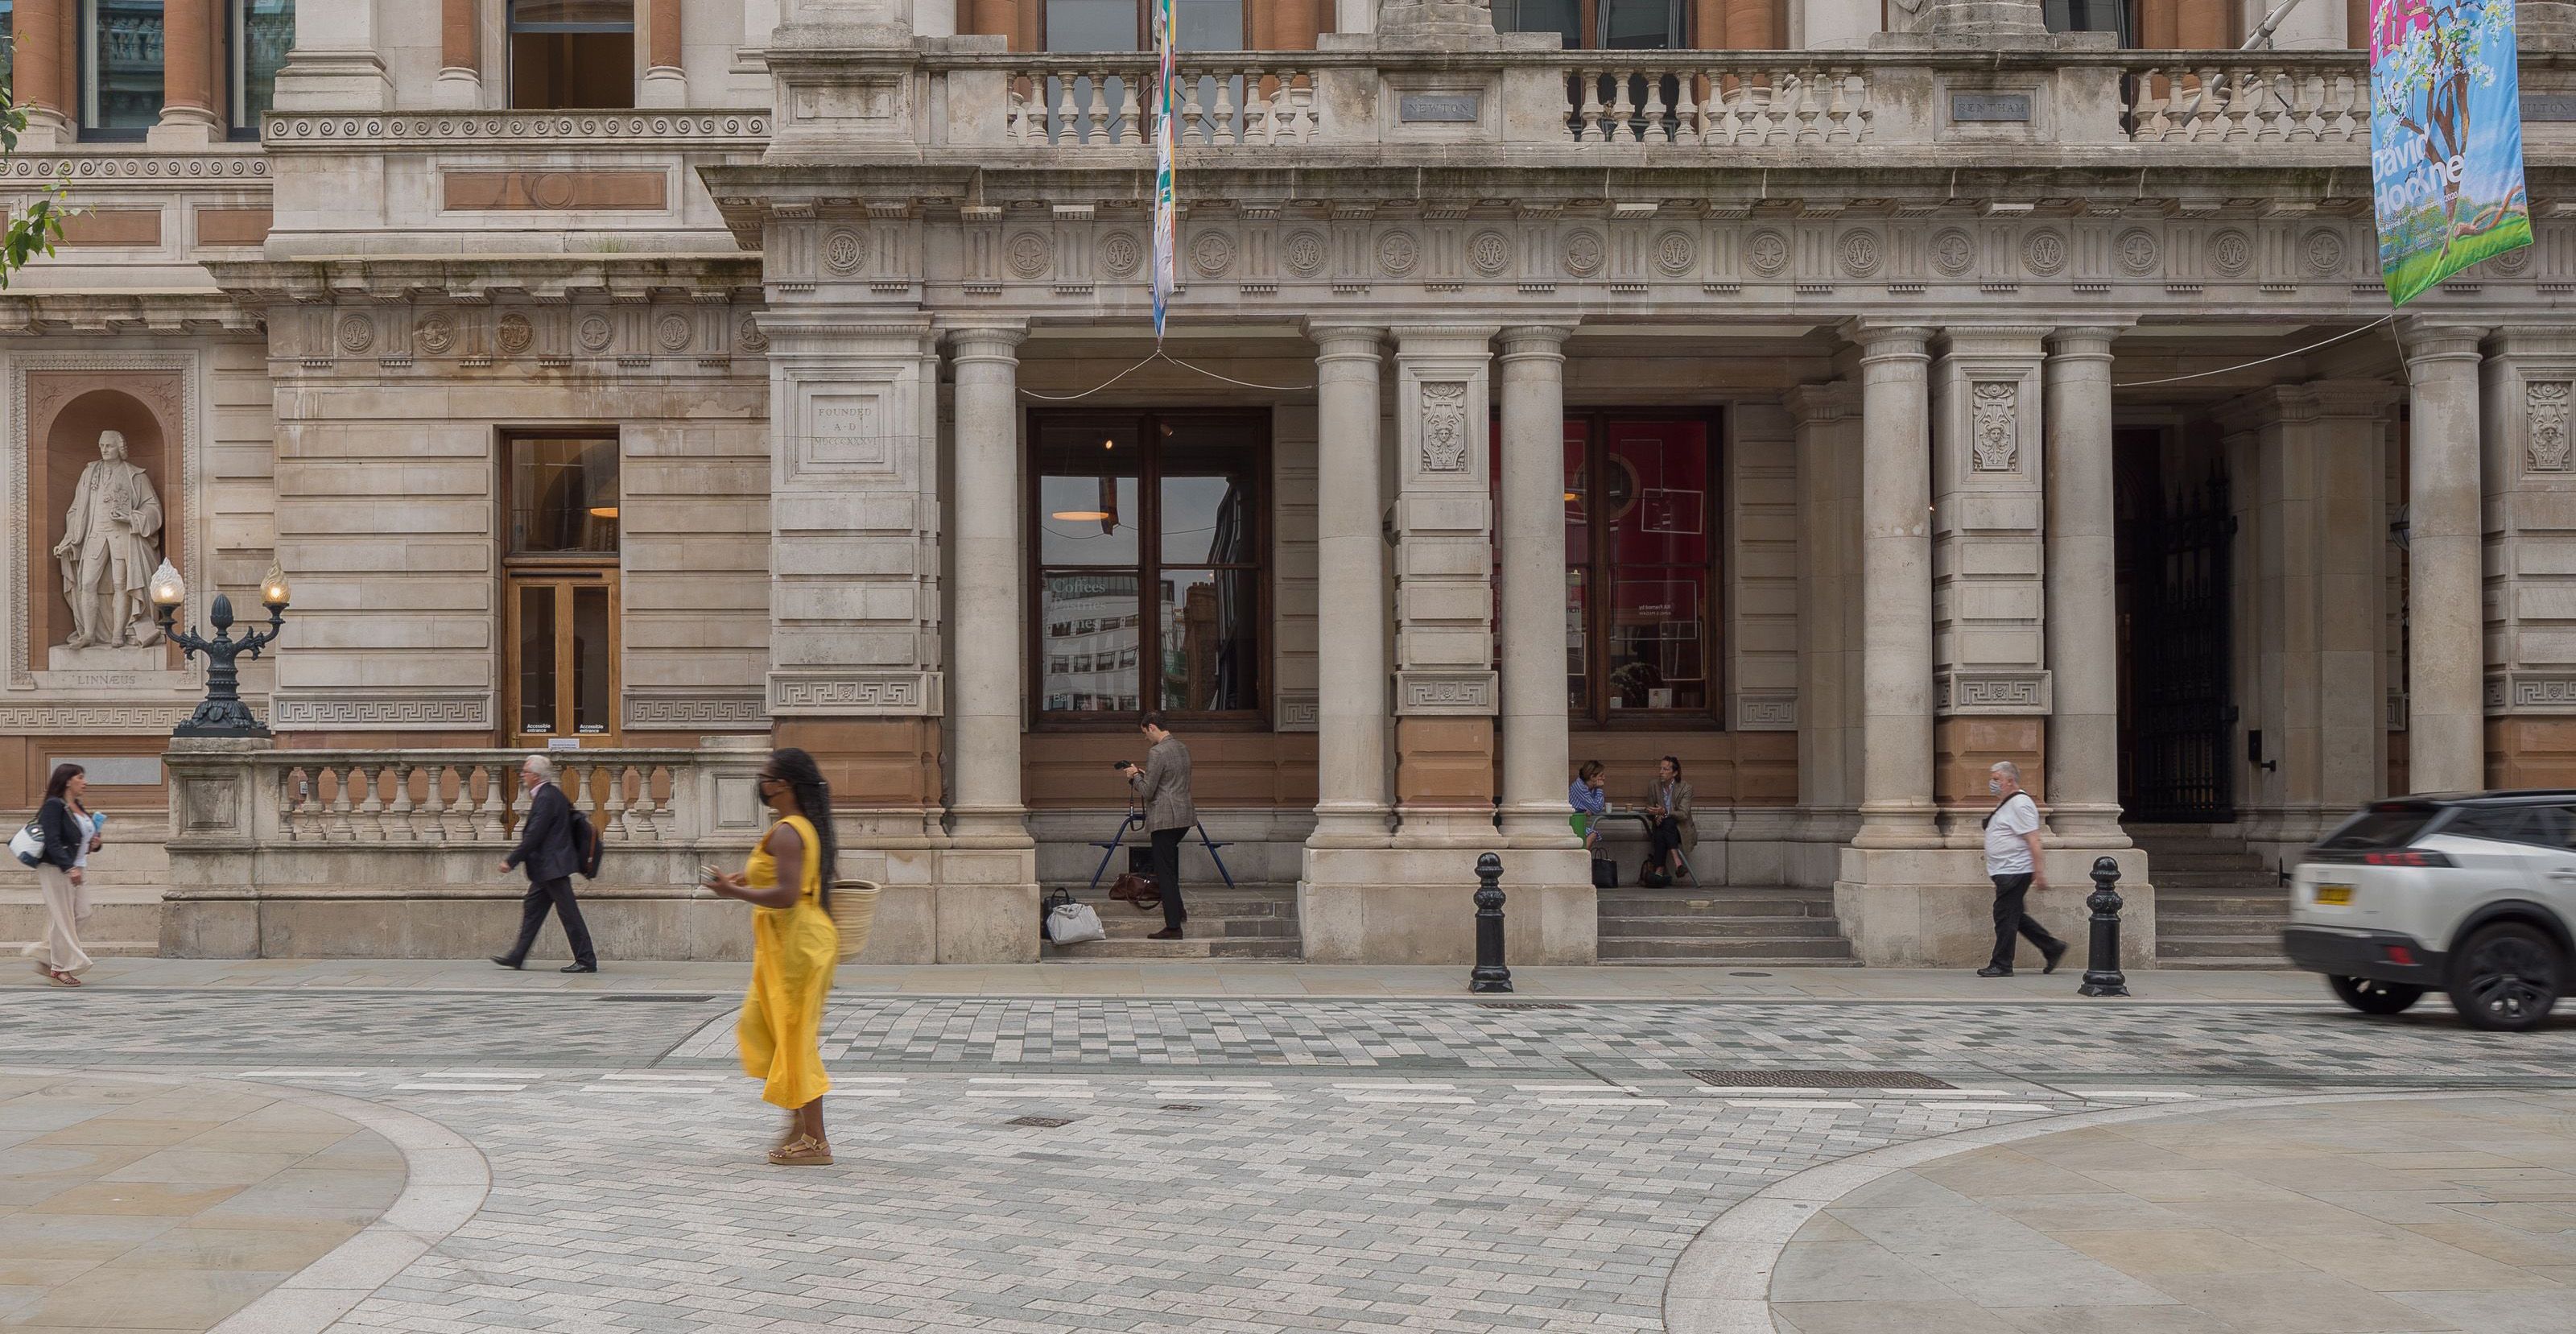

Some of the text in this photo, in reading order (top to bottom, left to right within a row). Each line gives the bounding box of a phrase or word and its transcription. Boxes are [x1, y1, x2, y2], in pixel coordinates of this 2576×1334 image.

[1408, 104, 1469, 114] NEWTON
[1958, 103, 2025, 113] BENTHAM
[2372, 122, 2429, 184] David
[2374, 152, 2465, 216] Hockne
[2444, 191, 2458, 202] 2020
[819, 408, 872, 416] FOUNDED
[1053, 579, 1106, 593] Coffees
[1054, 597, 1107, 611] Pastries
